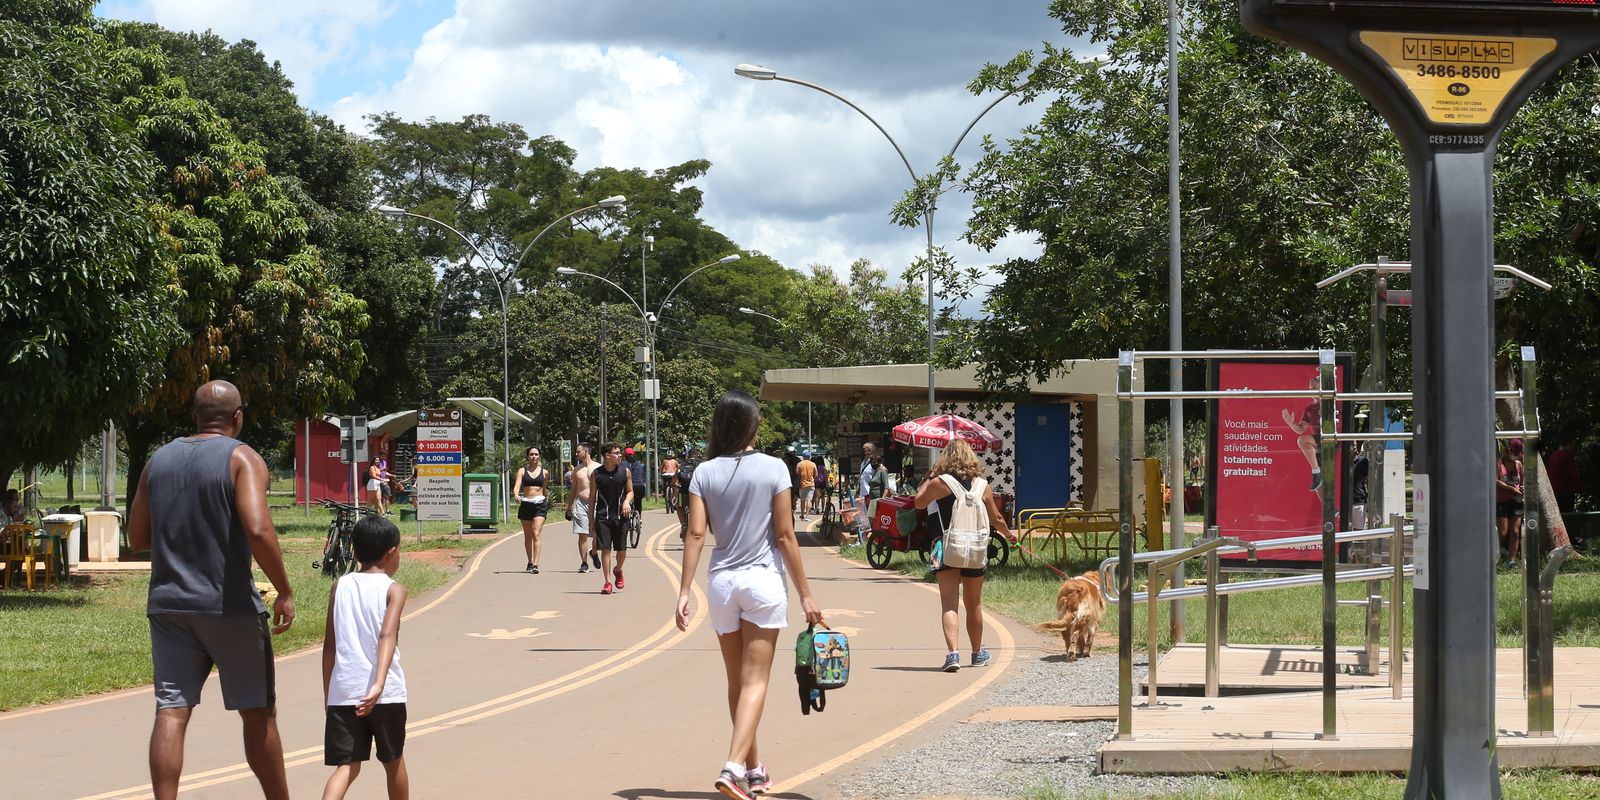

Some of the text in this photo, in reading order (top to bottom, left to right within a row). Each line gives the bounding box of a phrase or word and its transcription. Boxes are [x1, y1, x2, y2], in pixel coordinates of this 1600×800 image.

[1405, 43, 1511, 58] VISUPLAC
[1417, 64, 1501, 79] 3486-8500
[1224, 419, 1269, 429] Você mais
[1224, 431, 1262, 440] saudável
[919, 437, 943, 446] KIBON
[1223, 443, 1269, 452] atividades
[1223, 455, 1273, 465] totalmente
[1223, 467, 1267, 478] gratuitas!
